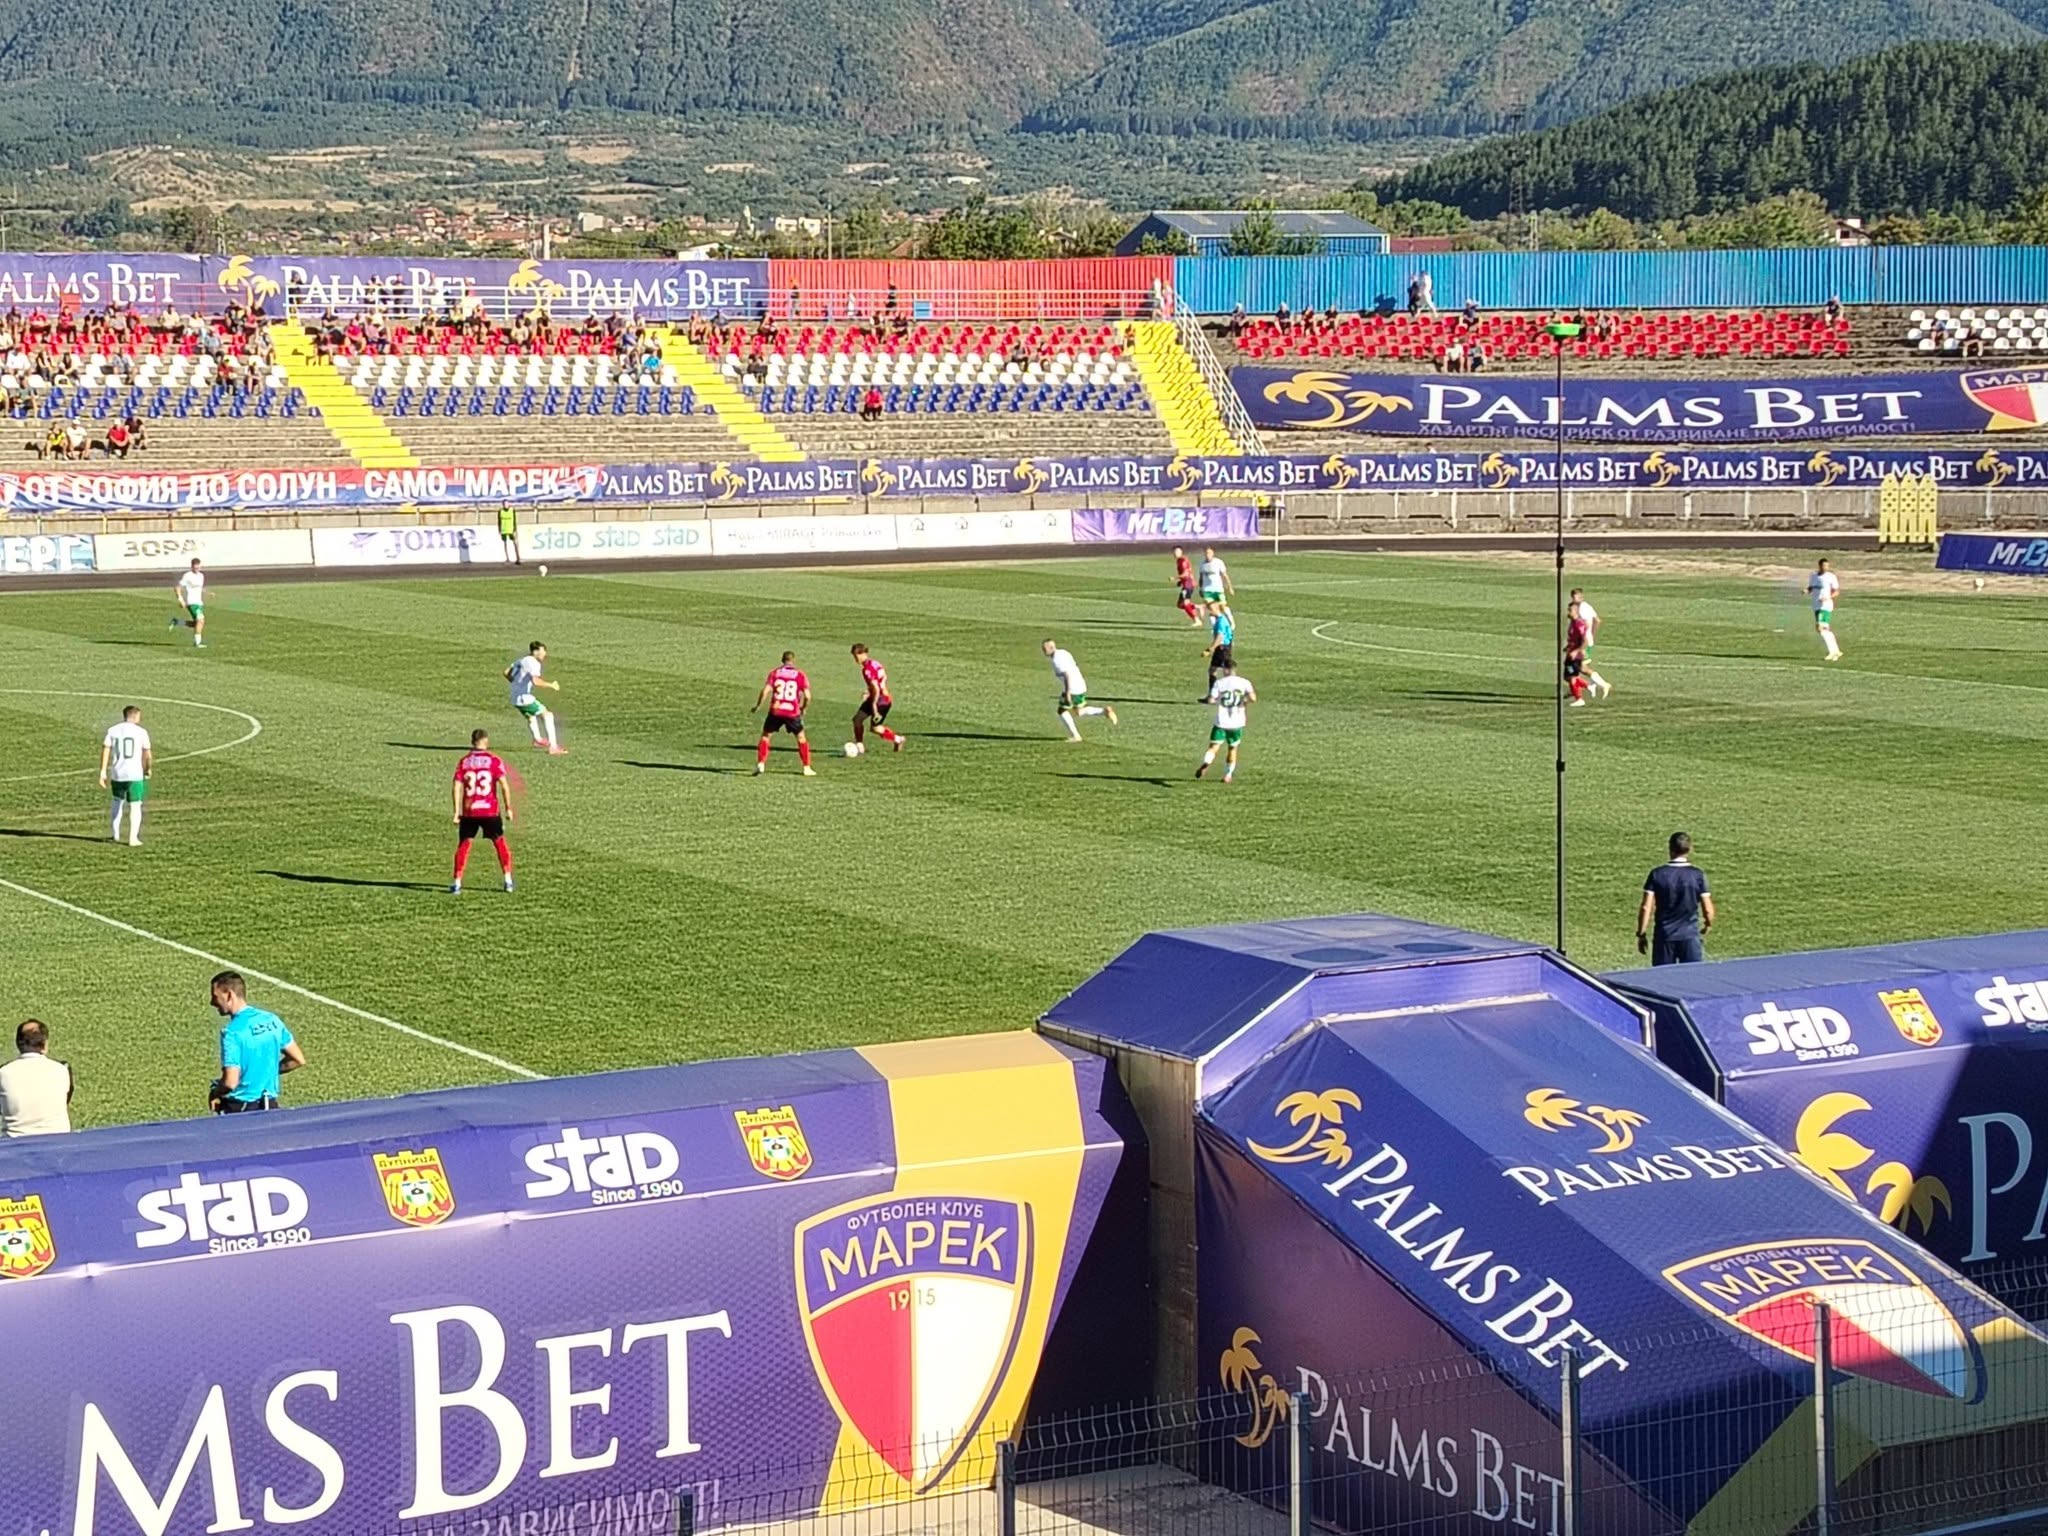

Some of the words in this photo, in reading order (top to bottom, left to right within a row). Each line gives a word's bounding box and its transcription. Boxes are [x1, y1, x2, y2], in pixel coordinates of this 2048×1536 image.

[107, 263, 180, 307] BET
[568, 269, 678, 308] PALMS
[686, 269, 750, 309] BET
[1419, 383, 1725, 428] PALMS
[1744, 387, 1923, 429] BET
[1754, 428, 1781, 439] НА
[667, 468, 708, 496] BET
[746, 467, 815, 493] PALMS
[818, 465, 857, 492] BET
[897, 464, 967, 491] PALMS
[971, 463, 1011, 490] BET
[1050, 461, 1120, 488] PALMS
[1123, 460, 1164, 487] BET
[1203, 460, 1275, 486] PALMS
[1279, 458, 1320, 486] BET
[1359, 458, 1432, 485] PALMS
[1435, 457, 1477, 484] BET
[1519, 457, 1594, 483] PALMS
[1597, 456, 1641, 482] BET
[1681, 456, 1758, 482] PALMS
[1760, 455, 1805, 482] BET
[1928, 455, 1973, 481] BET
[71, 475, 179, 504] СОФИЯ
[186, 474, 230, 503] ДО
[237, 472, 337, 501] СОЛУН
[364, 469, 447, 498] САМО
[1126, 508, 1208, 534] MrBit
[1987, 540, 2048, 567] MrB
[774, 678, 799, 702] 38
[463, 770, 492, 797] 33
[1502, 1154, 1693, 1206] PALMS
[1671, 1144, 1786, 1180] BET
[592, 1187, 636, 1206] Since
[640, 1179, 684, 1200] 1990
[847, 1202, 937, 1231] ФУТБОЛЕН
[940, 1201, 984, 1219] КЛУБ
[208, 1236, 259, 1256] Since
[263, 1227, 311, 1246] 1990
[819, 1219, 1008, 1292] МАРЕК
[1322, 1142, 1521, 1305] PALMS
[1484, 1277, 1630, 1379] BET
[1709, 1247, 1791, 1273] ФУТБОЛЕН
[1700, 1255, 1893, 1304] МАРЕК
[40, 1369, 345, 1536] MS
[389, 1304, 733, 1520] BET
[1296, 1365, 1458, 1499] PALMS
[1471, 1428, 1566, 1536] BET
